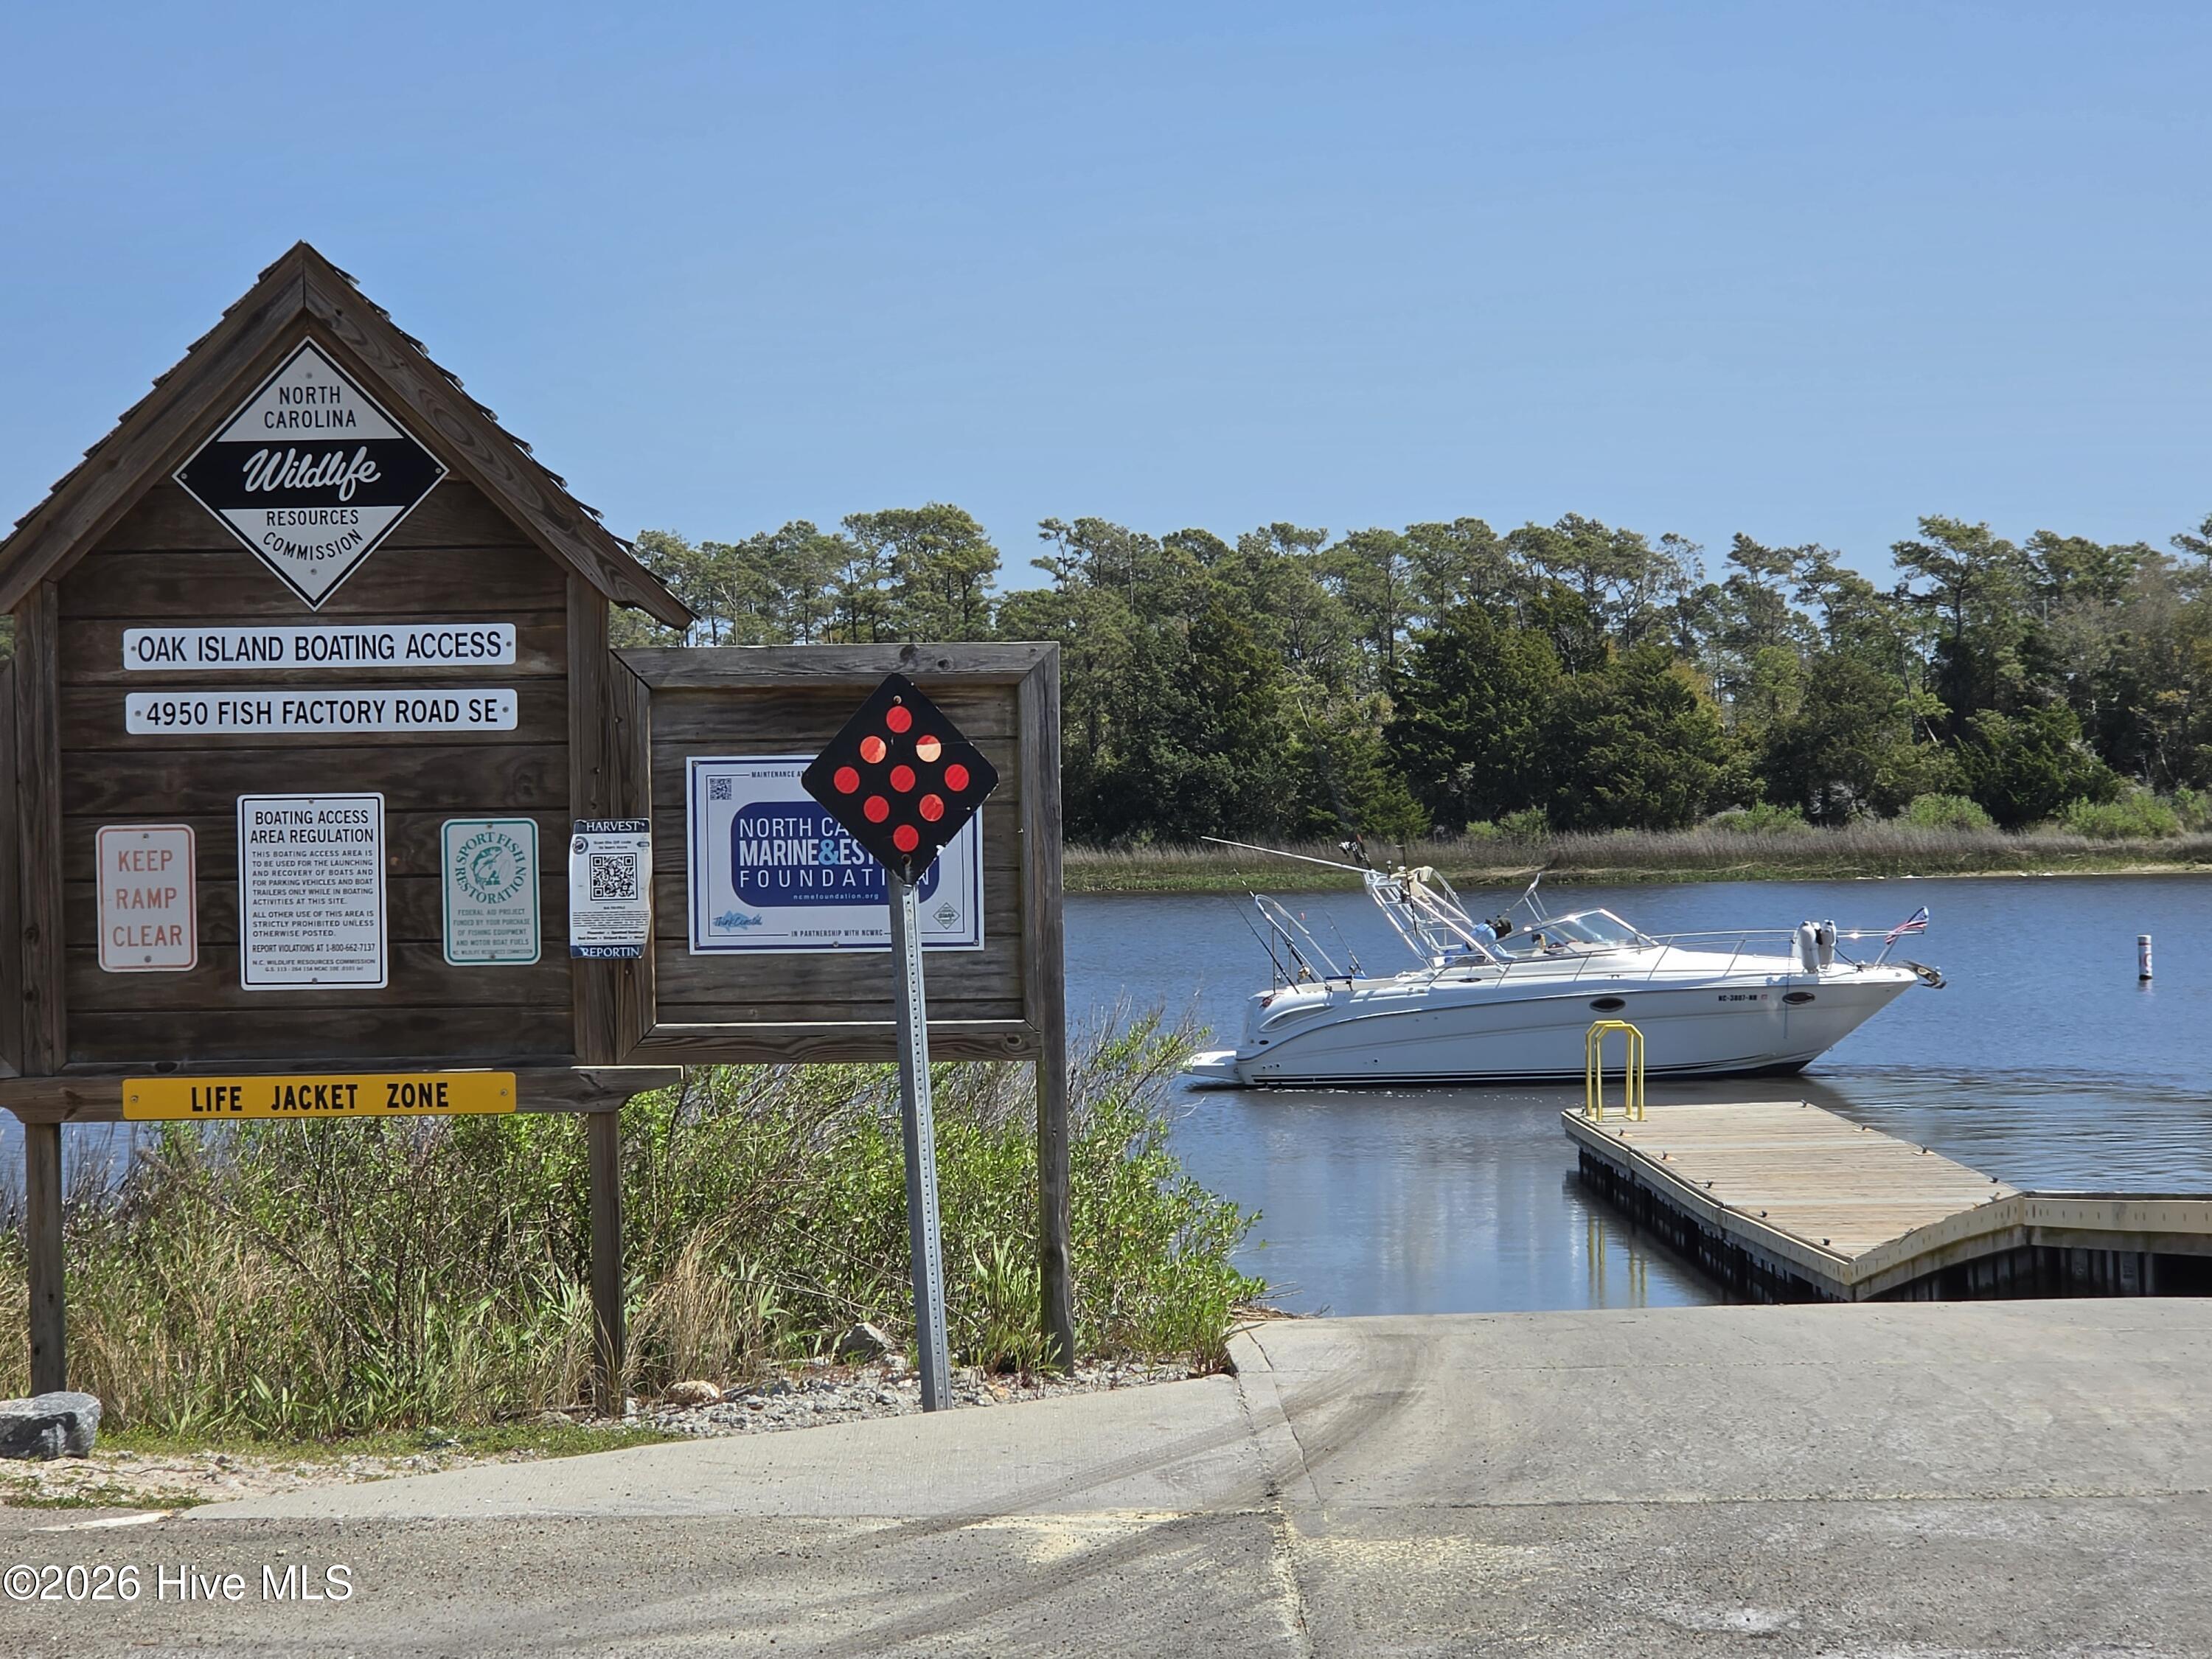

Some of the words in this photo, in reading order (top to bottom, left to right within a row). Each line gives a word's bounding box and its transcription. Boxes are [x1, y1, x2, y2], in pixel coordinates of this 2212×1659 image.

[279, 386, 341, 405] NORTH
[264, 409, 357, 428] CAROLINA
[243, 446, 381, 501] Wildlife
[266, 509, 359, 526] RESOURCES
[263, 529, 364, 560] COMMISSION
[138, 635, 187, 662] OAK
[198, 635, 284, 662] ISLAND
[294, 633, 394, 661] BOATING
[406, 630, 502, 658] ACCESS
[147, 701, 208, 726] 4950
[218, 700, 272, 725] FISH
[282, 699, 386, 725] FACTORY
[395, 699, 459, 723] ROAD
[468, 698, 498, 723] SE
[255, 810, 313, 825] BOATING
[318, 810, 369, 824] ACCESS
[586, 821, 640, 832] HARVEST
[740, 817, 812, 838] NORTH
[250, 830, 285, 844] AREA
[290, 828, 374, 844] REGULATION
[456, 832, 495, 865] SPORT
[496, 833, 526, 863] FISH
[119, 850, 173, 872] KEEP
[455, 866, 527, 904] RESTORATION
[116, 887, 177, 910] RAMP
[793, 892, 880, 901] ncmefoundation.org
[113, 925, 183, 947] CLEAR
[252, 944, 277, 953] REPORT
[278, 944, 315, 952] VIOLATIONS
[316, 944, 324, 952] AT
[191, 1085, 243, 1112] LIFE
[271, 1084, 358, 1110] JACKET
[386, 1082, 449, 1108] ZONE
